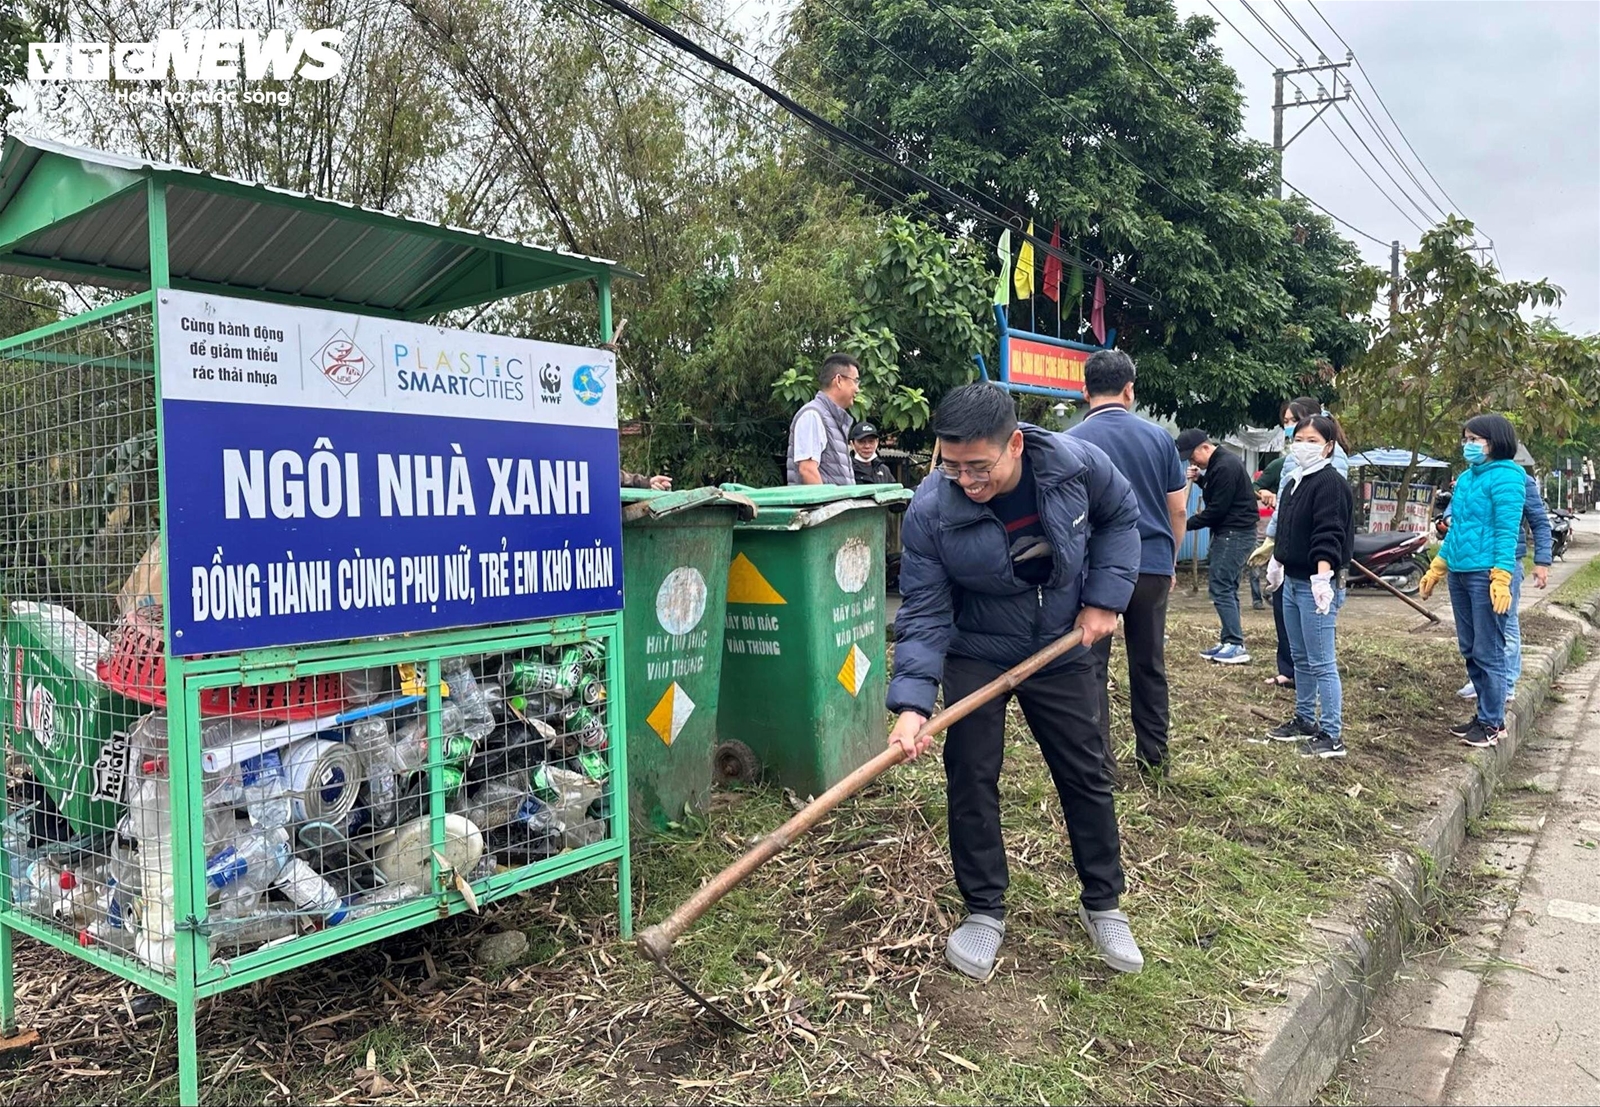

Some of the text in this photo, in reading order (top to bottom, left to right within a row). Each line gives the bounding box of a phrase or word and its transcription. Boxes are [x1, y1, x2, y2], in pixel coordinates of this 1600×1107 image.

[181, 317, 284, 342] Cùng hành động
[190, 339, 278, 363] để giảm thiểu
[394, 343, 524, 380] PLASTIC
[192, 366, 278, 387] rác thải nhựa
[540, 394, 562, 404] WWF
[222, 436, 590, 520] NGÔI NHÀ XANH
[191, 536, 614, 622] ĐỒNG HÀNH CÙNG PHỤ NỮ, TRẺ EM KHÓ KHĂN
[757, 613, 780, 631] RÁC
[726, 636, 781, 656] VÀO THÙNG
[647, 658, 669, 681] VÀO
